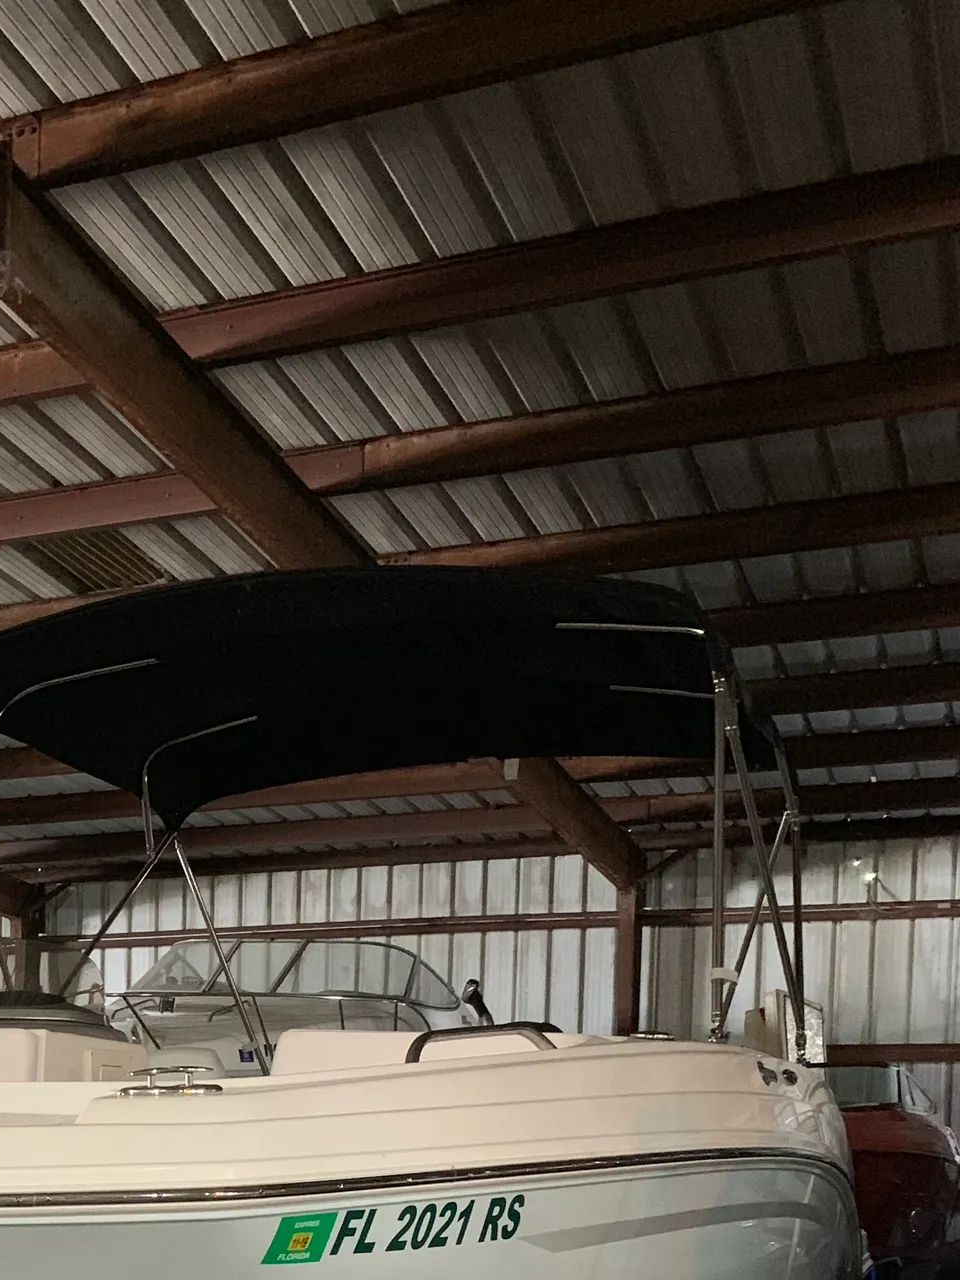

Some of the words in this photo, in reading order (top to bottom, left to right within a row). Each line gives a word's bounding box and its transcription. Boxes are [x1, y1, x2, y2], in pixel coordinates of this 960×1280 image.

[329, 1208, 378, 1256] FL
[384, 1199, 476, 1252] 2021
[477, 1193, 526, 1243] RS
[276, 1251, 311, 1261] FLORIDA
